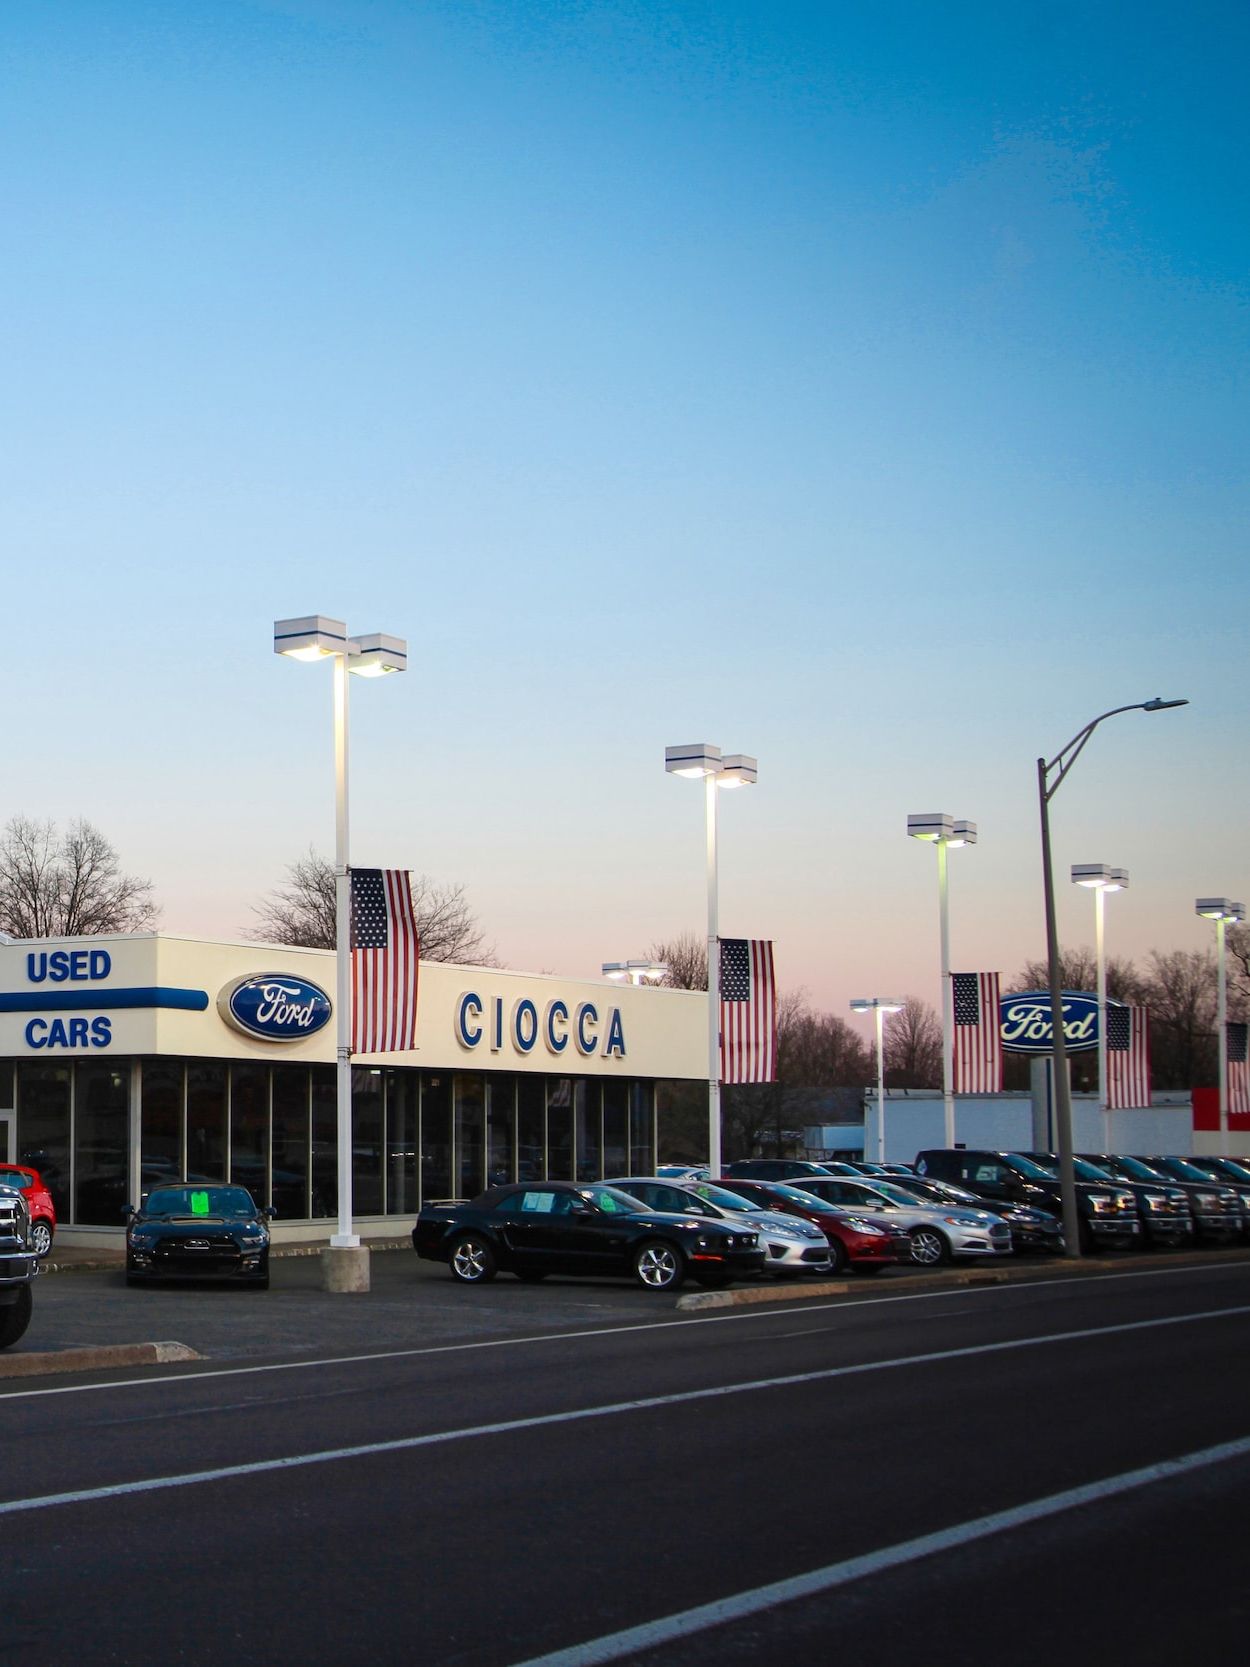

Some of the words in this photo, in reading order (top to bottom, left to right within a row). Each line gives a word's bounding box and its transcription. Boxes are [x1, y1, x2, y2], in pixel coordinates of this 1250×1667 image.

[27, 950, 111, 982] USED
[256, 983, 314, 1027] Ford
[25, 1016, 111, 1048] CARS
[454, 991, 626, 1058] CIOCCA
